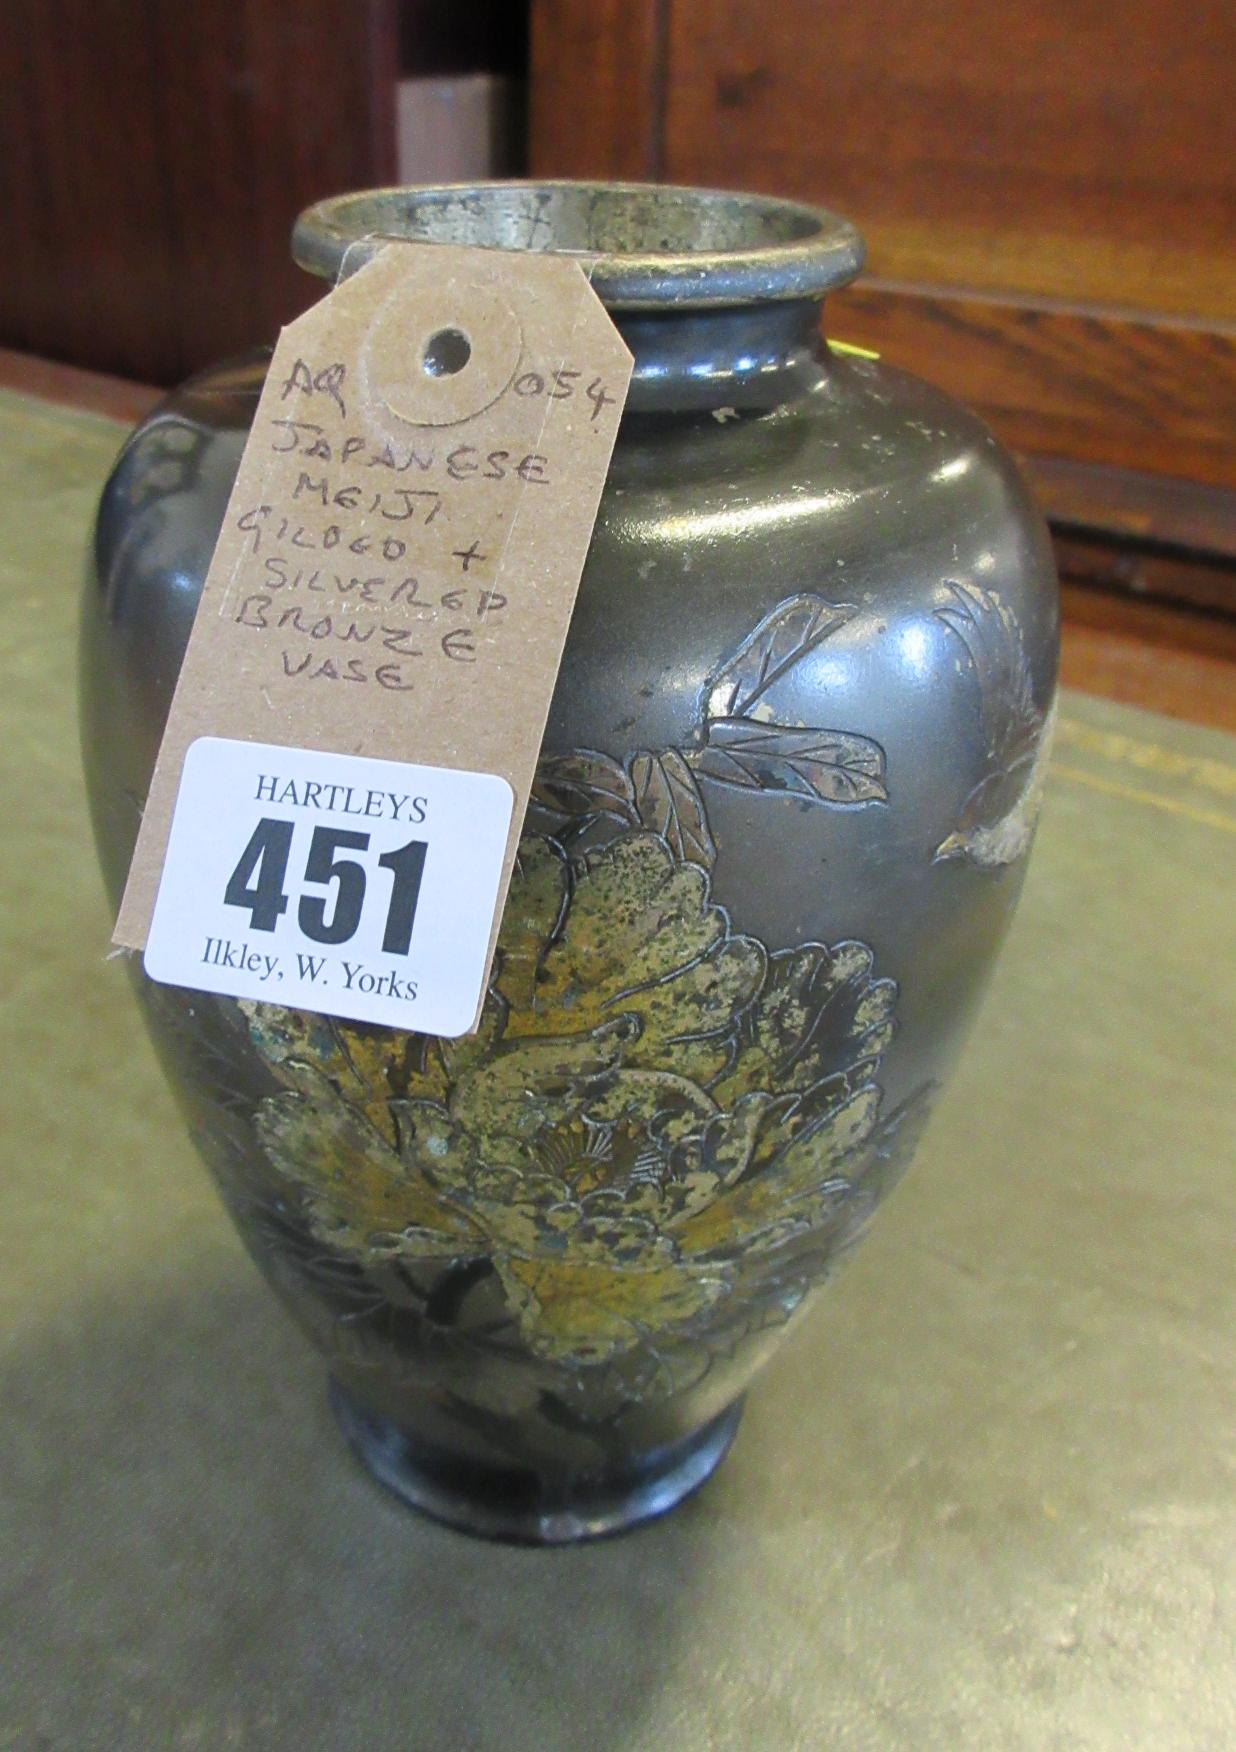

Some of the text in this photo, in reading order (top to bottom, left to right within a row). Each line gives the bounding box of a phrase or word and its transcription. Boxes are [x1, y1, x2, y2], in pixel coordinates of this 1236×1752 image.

[271, 420, 550, 484] JAPANESE
[294, 473, 442, 525] MEIJI
[265, 558, 507, 624] SILVERED
[235, 595, 476, 662] BRONZE
[282, 650, 413, 690] VASE
[254, 774, 428, 824] HARTLEYS
[223, 817, 429, 956] 451
[201, 936, 418, 1001] Ilkley, W. Yorks
